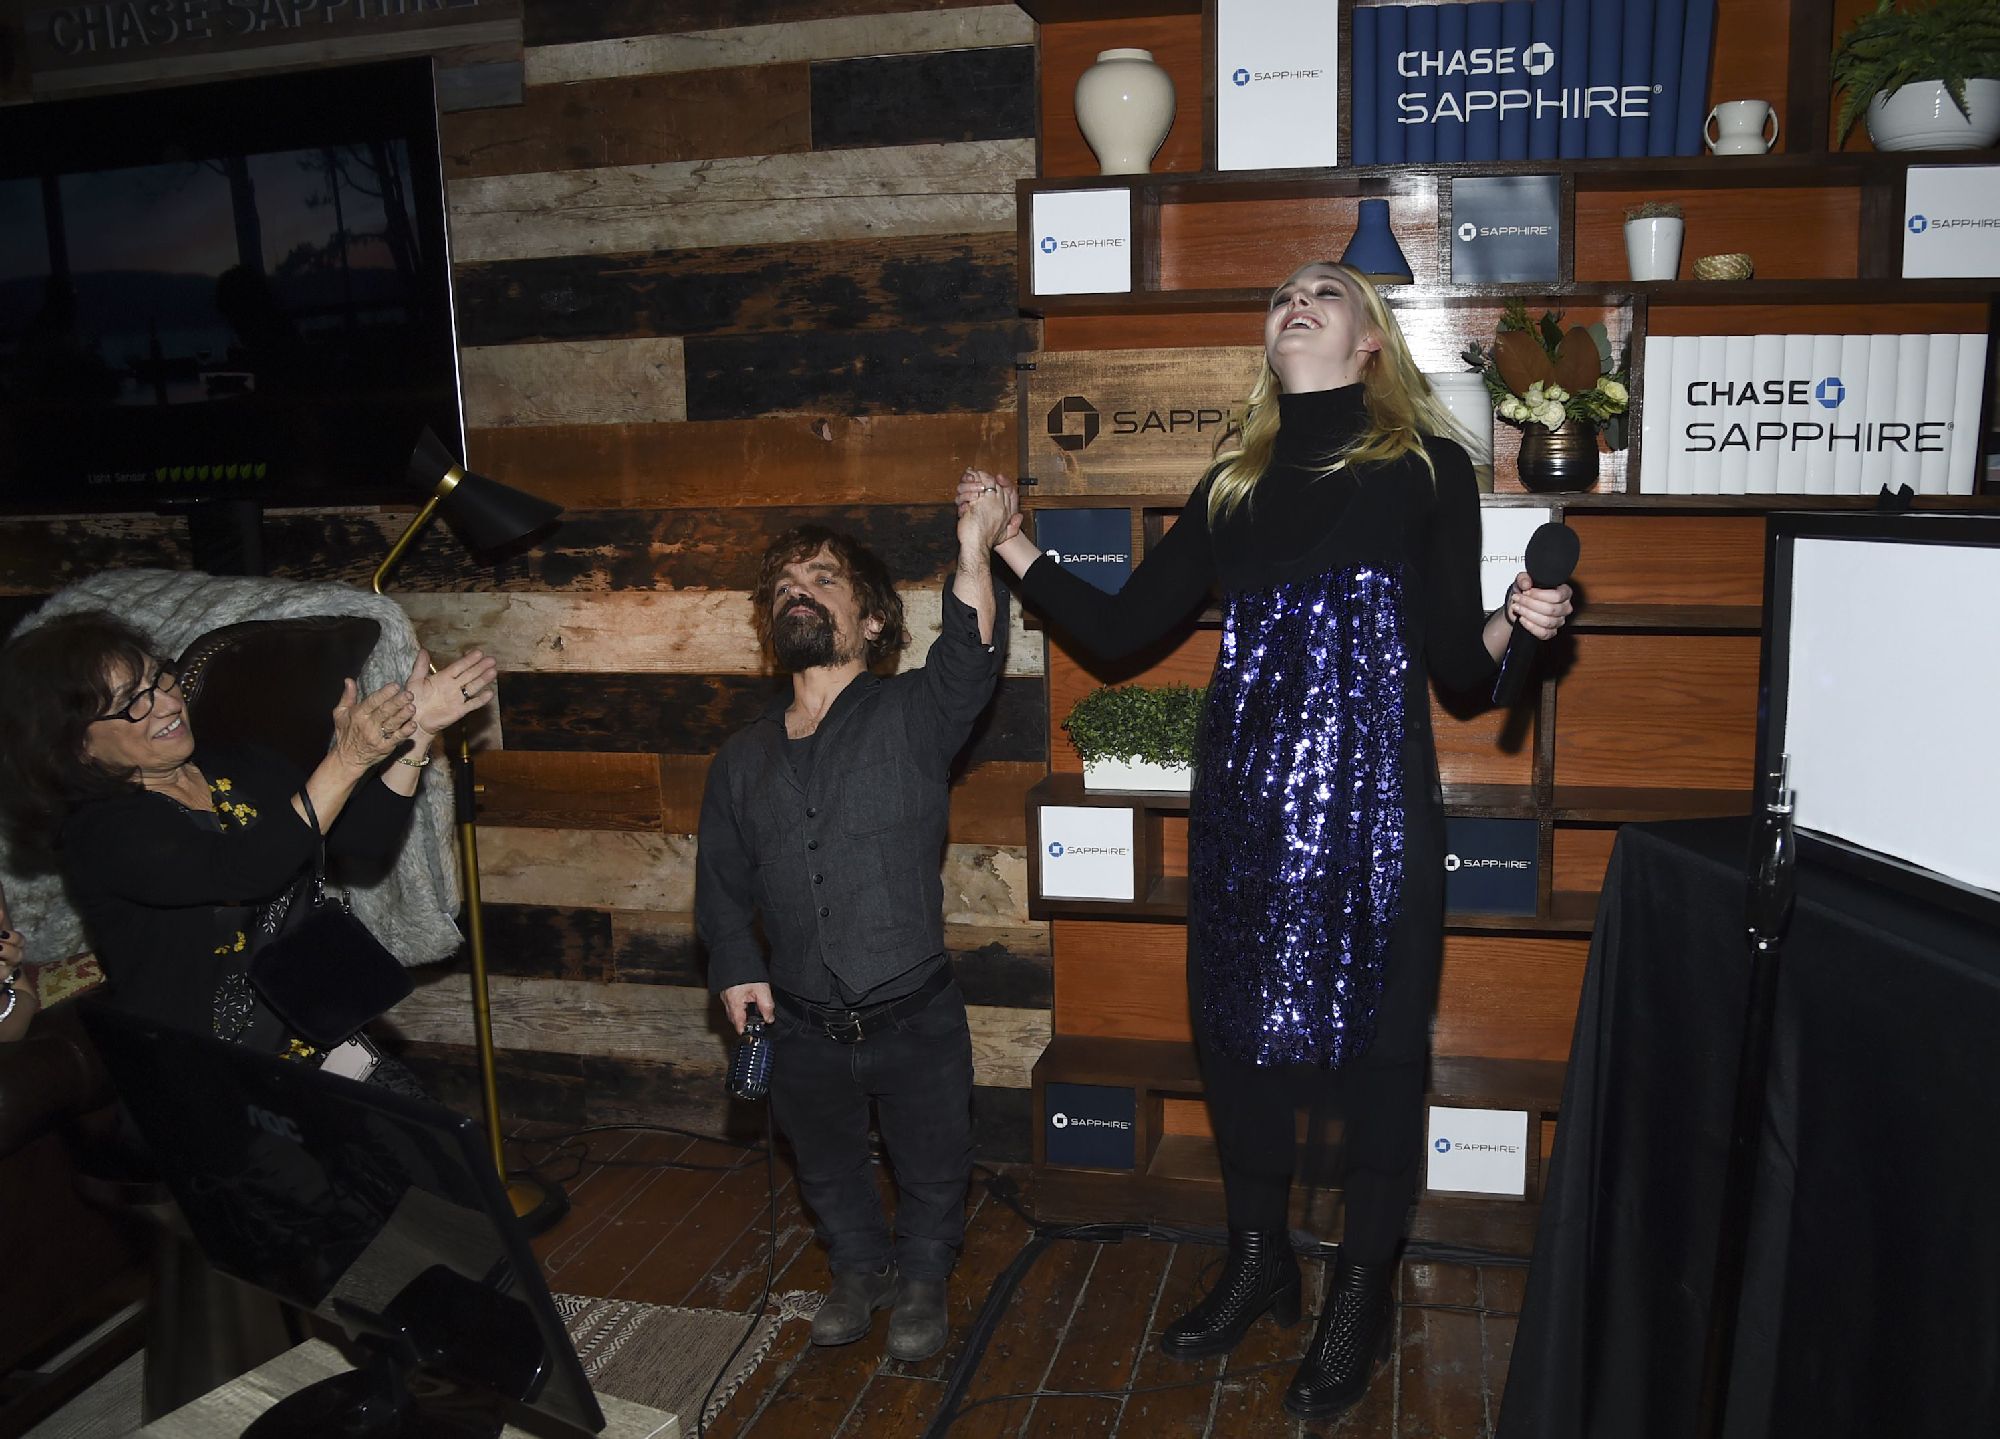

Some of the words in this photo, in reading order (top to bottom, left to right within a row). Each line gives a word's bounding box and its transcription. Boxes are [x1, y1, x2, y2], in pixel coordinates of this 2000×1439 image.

[50, 0, 213, 55] CHASE
[223, 0, 479, 34] SAPP
[1397, 46, 1516, 78] CHASE
[1254, 69, 1323, 81] SAPPHIRE
[1932, 218, 2000, 229] SAPPHIRE
[1480, 226, 1552, 237] SAPPHIRE
[1060, 238, 1125, 249] SAPPHIRE
[1687, 380, 1811, 406] CHASE
[1112, 408, 1249, 435] SAPPH
[1062, 554, 1128, 563] SAPPHIRE
[1067, 846, 1130, 856] SAPPHIRE
[1463, 859, 1531, 869] SAPPHIRE
[1070, 1118, 1131, 1130] SAPPHIRE
[1454, 1142, 1519, 1153] SAPPHIRE
